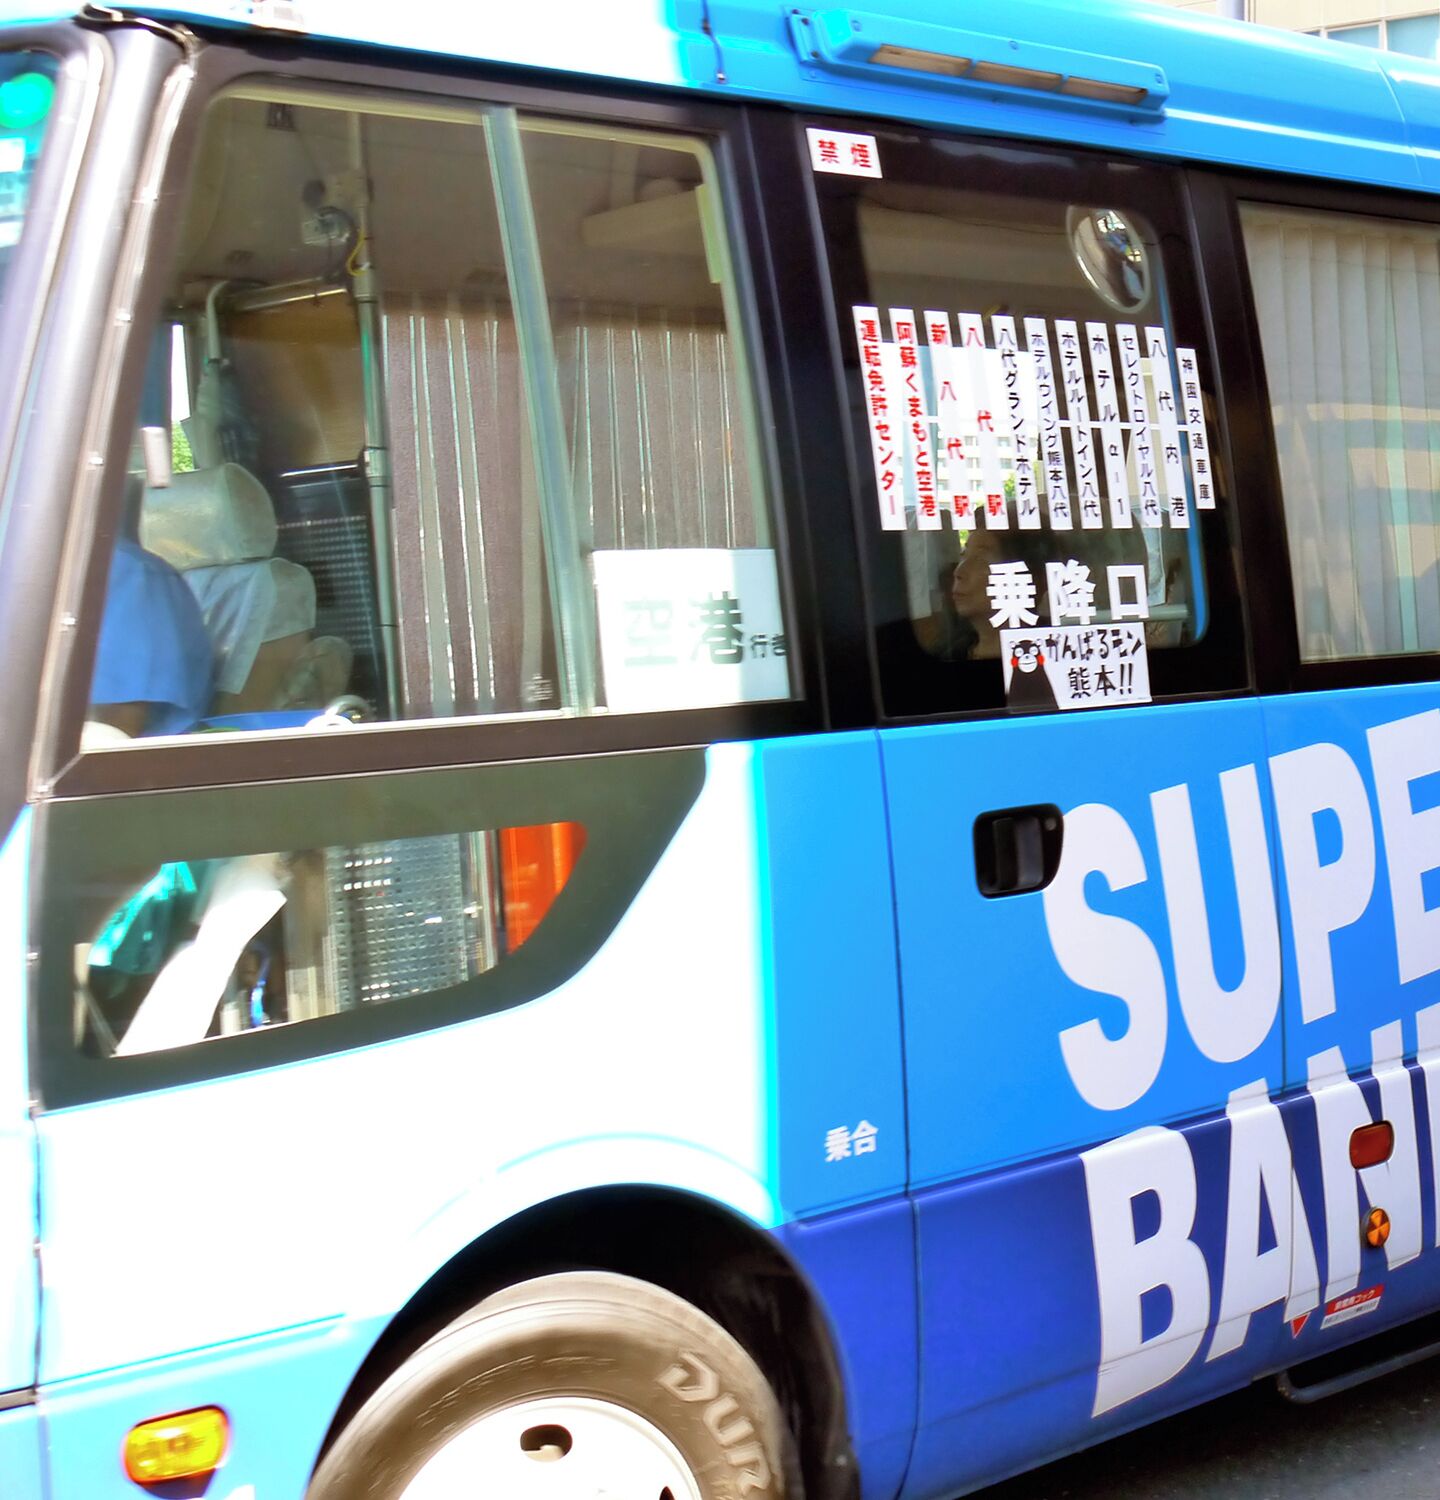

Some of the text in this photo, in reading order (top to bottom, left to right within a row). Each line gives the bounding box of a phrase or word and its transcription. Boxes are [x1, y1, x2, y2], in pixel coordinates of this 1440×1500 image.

[817, 139, 873, 169] 禁煙
[860, 318, 896, 515] 運転免許センター
[896, 321, 936, 517] 阿蘇くまもと空港
[930, 322, 973, 517] 新八代駅
[966, 327, 1006, 516] 八代駅
[999, 327, 1036, 516] 八代グランドホテル
[1061, 332, 1099, 518] ホテルルートイン八代
[1122, 335, 1158, 516] セレクトロイヤル八代
[1152, 339, 1185, 517] 八代内港
[986, 558, 1149, 628] 乗降口
[1045, 628, 1144, 662] がんばるモン
[1068, 662, 1133, 699] 熊本!!
[823, 1119, 879, 1162] 乗合
